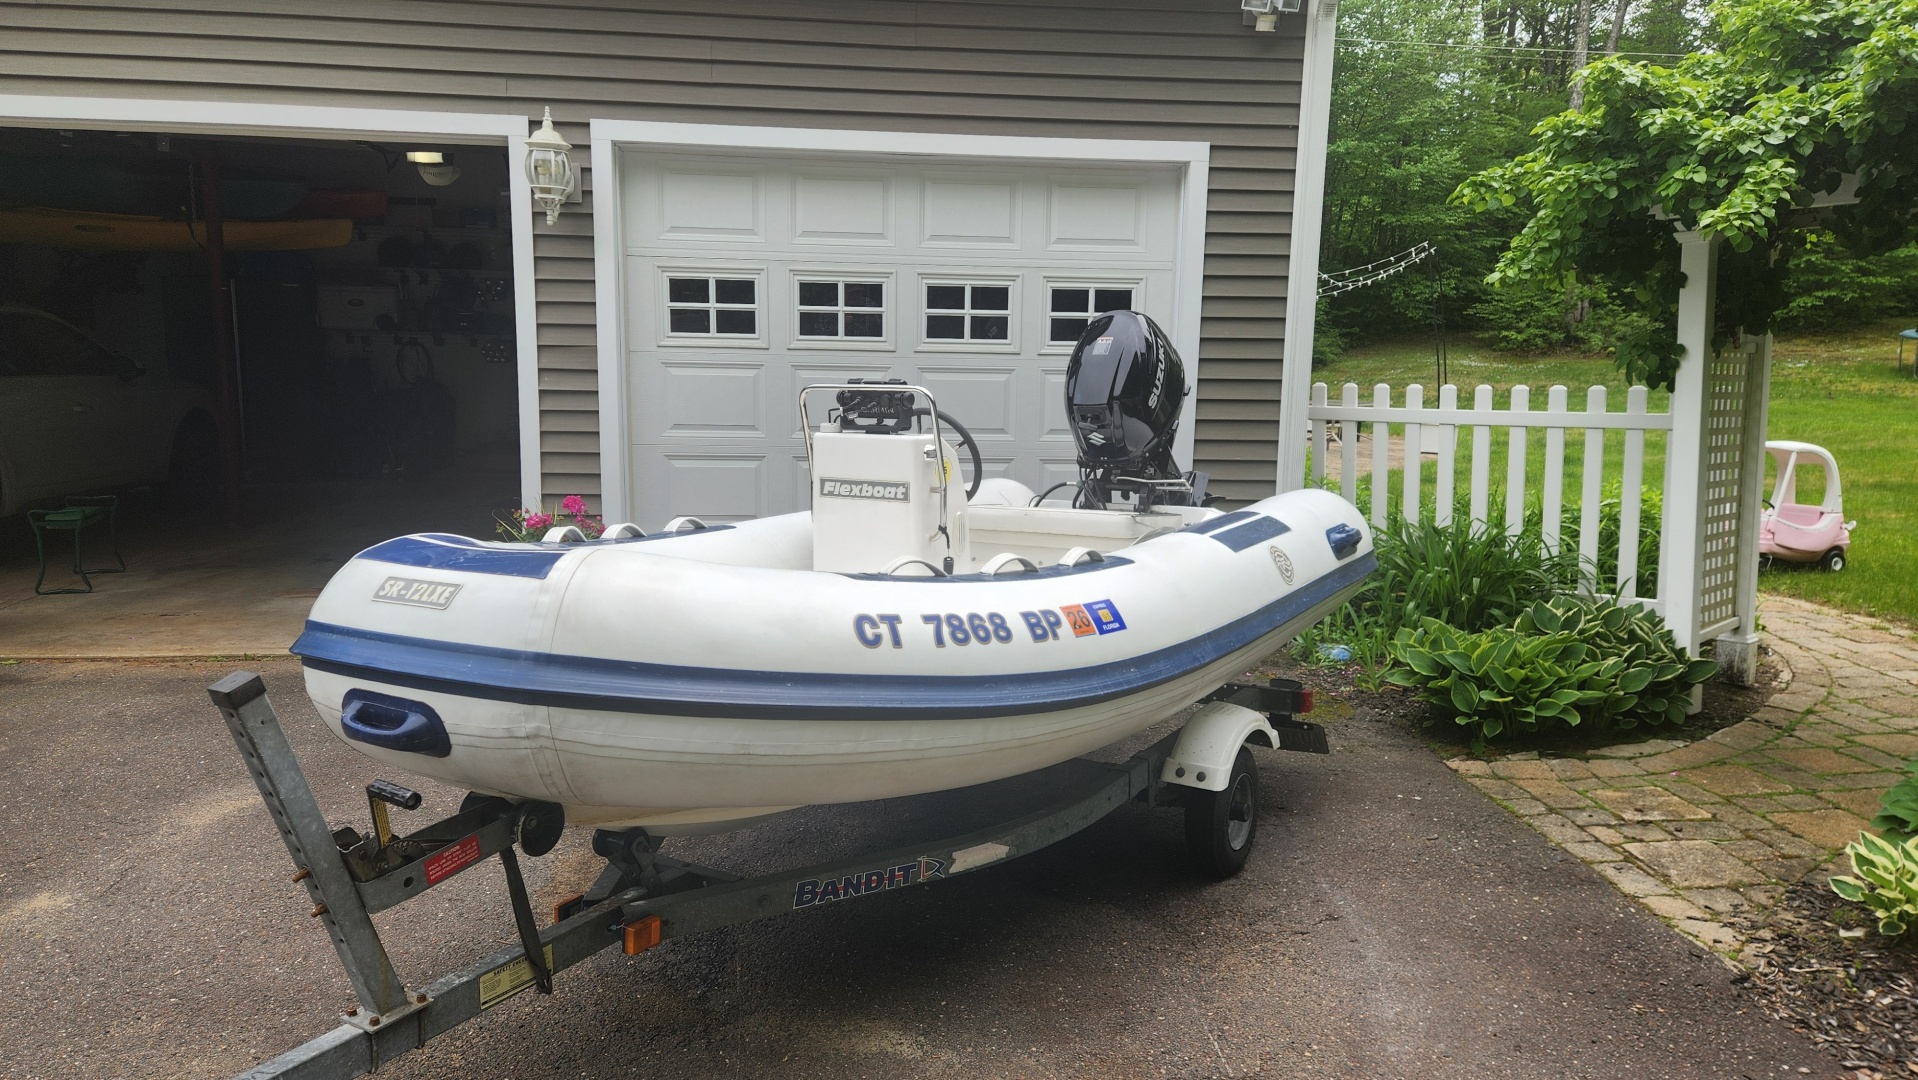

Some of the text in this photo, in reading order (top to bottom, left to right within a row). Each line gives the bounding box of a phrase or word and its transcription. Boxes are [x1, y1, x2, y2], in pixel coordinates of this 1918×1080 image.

[1148, 336, 1165, 409] SUZUKI
[822, 481, 906, 499] Flexboat
[378, 580, 455, 604] SR-12LXE
[853, 608, 1063, 649] CT 7868 BP
[1067, 610, 1091, 630] 26
[1102, 622, 1121, 631] FLORIDA
[792, 862, 918, 909] BANDIT
[493, 964, 511, 977] SAFETY
